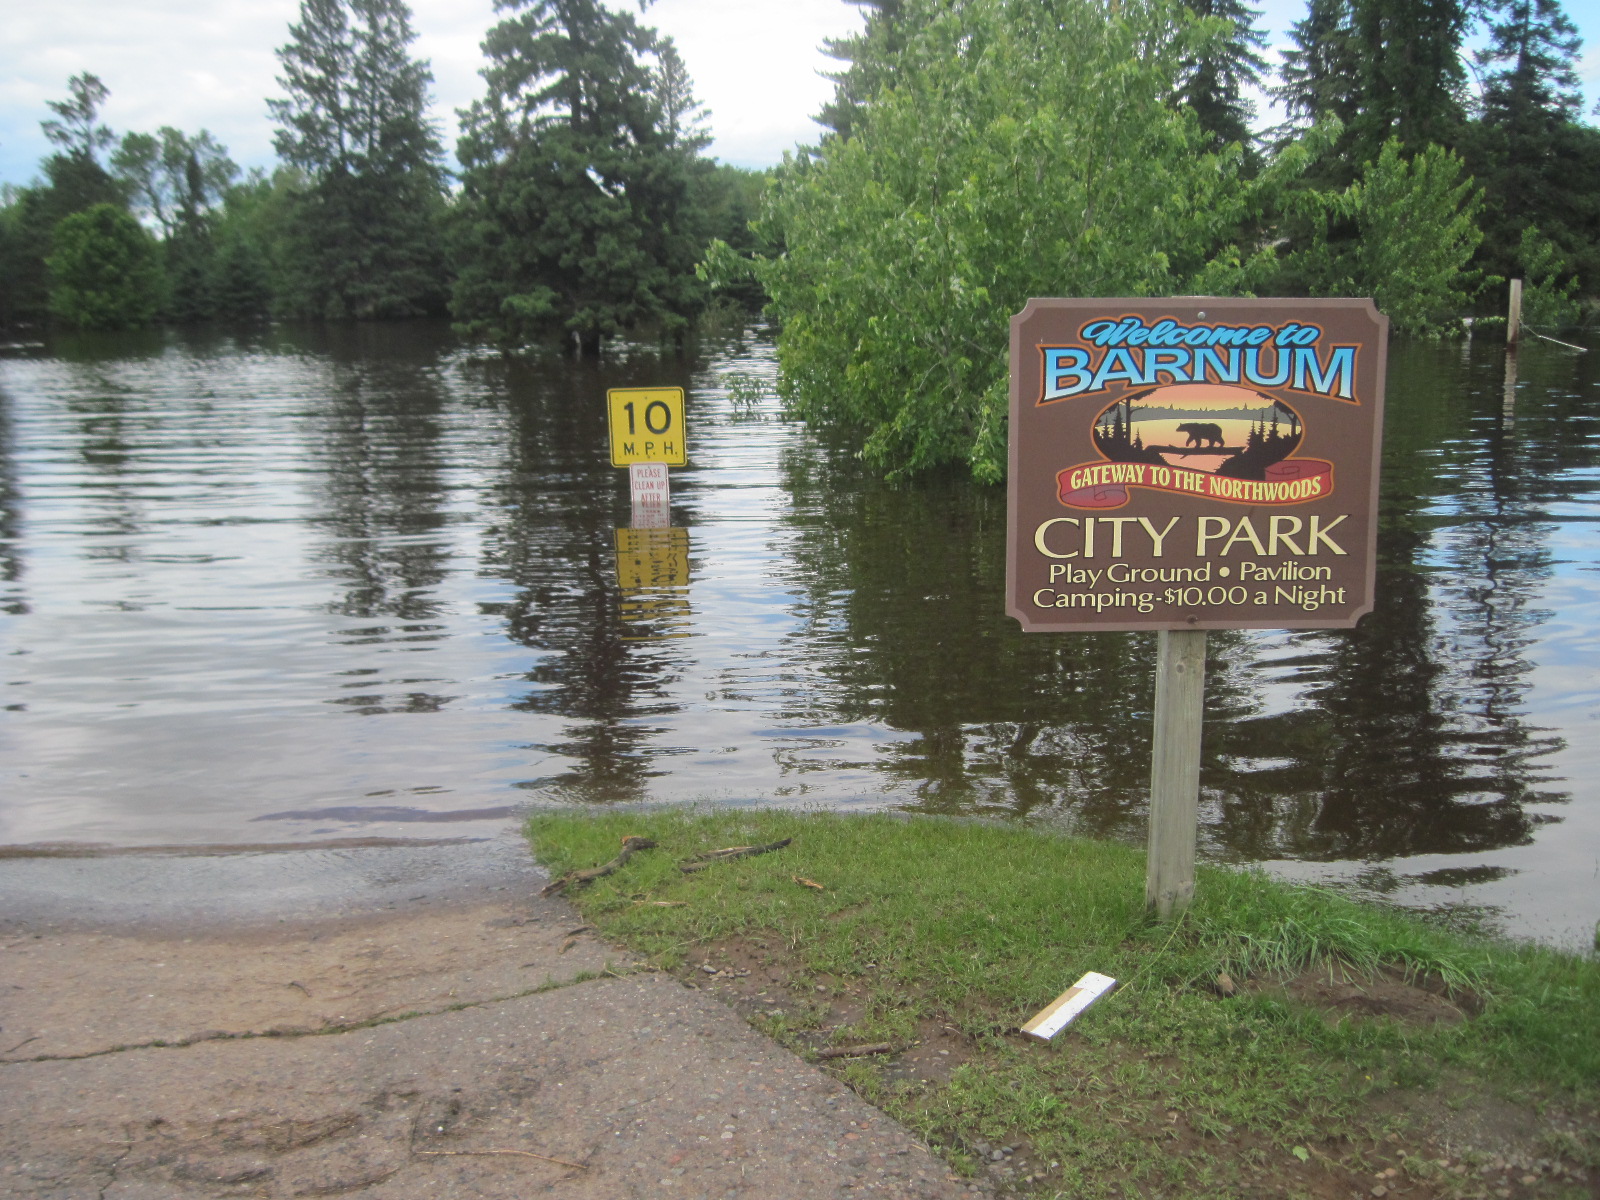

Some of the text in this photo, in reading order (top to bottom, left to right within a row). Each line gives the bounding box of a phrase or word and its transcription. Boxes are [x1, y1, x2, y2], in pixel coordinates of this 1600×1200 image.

[1083, 316, 1320, 346] Welcome to
[1042, 346, 1356, 401] BARNUM
[624, 400, 671, 435] 10
[634, 481, 665, 491] CLEAN UP
[637, 468, 661, 478] PLEASE
[1070, 464, 1322, 501] GATEWAY TO THE NORTHWOODS
[1034, 514, 1350, 559] CITY PARK
[1049, 561, 1331, 589] Play Ground Pavilion
[1253, 592, 1268, 605] a
[1274, 585, 1346, 611] Night
